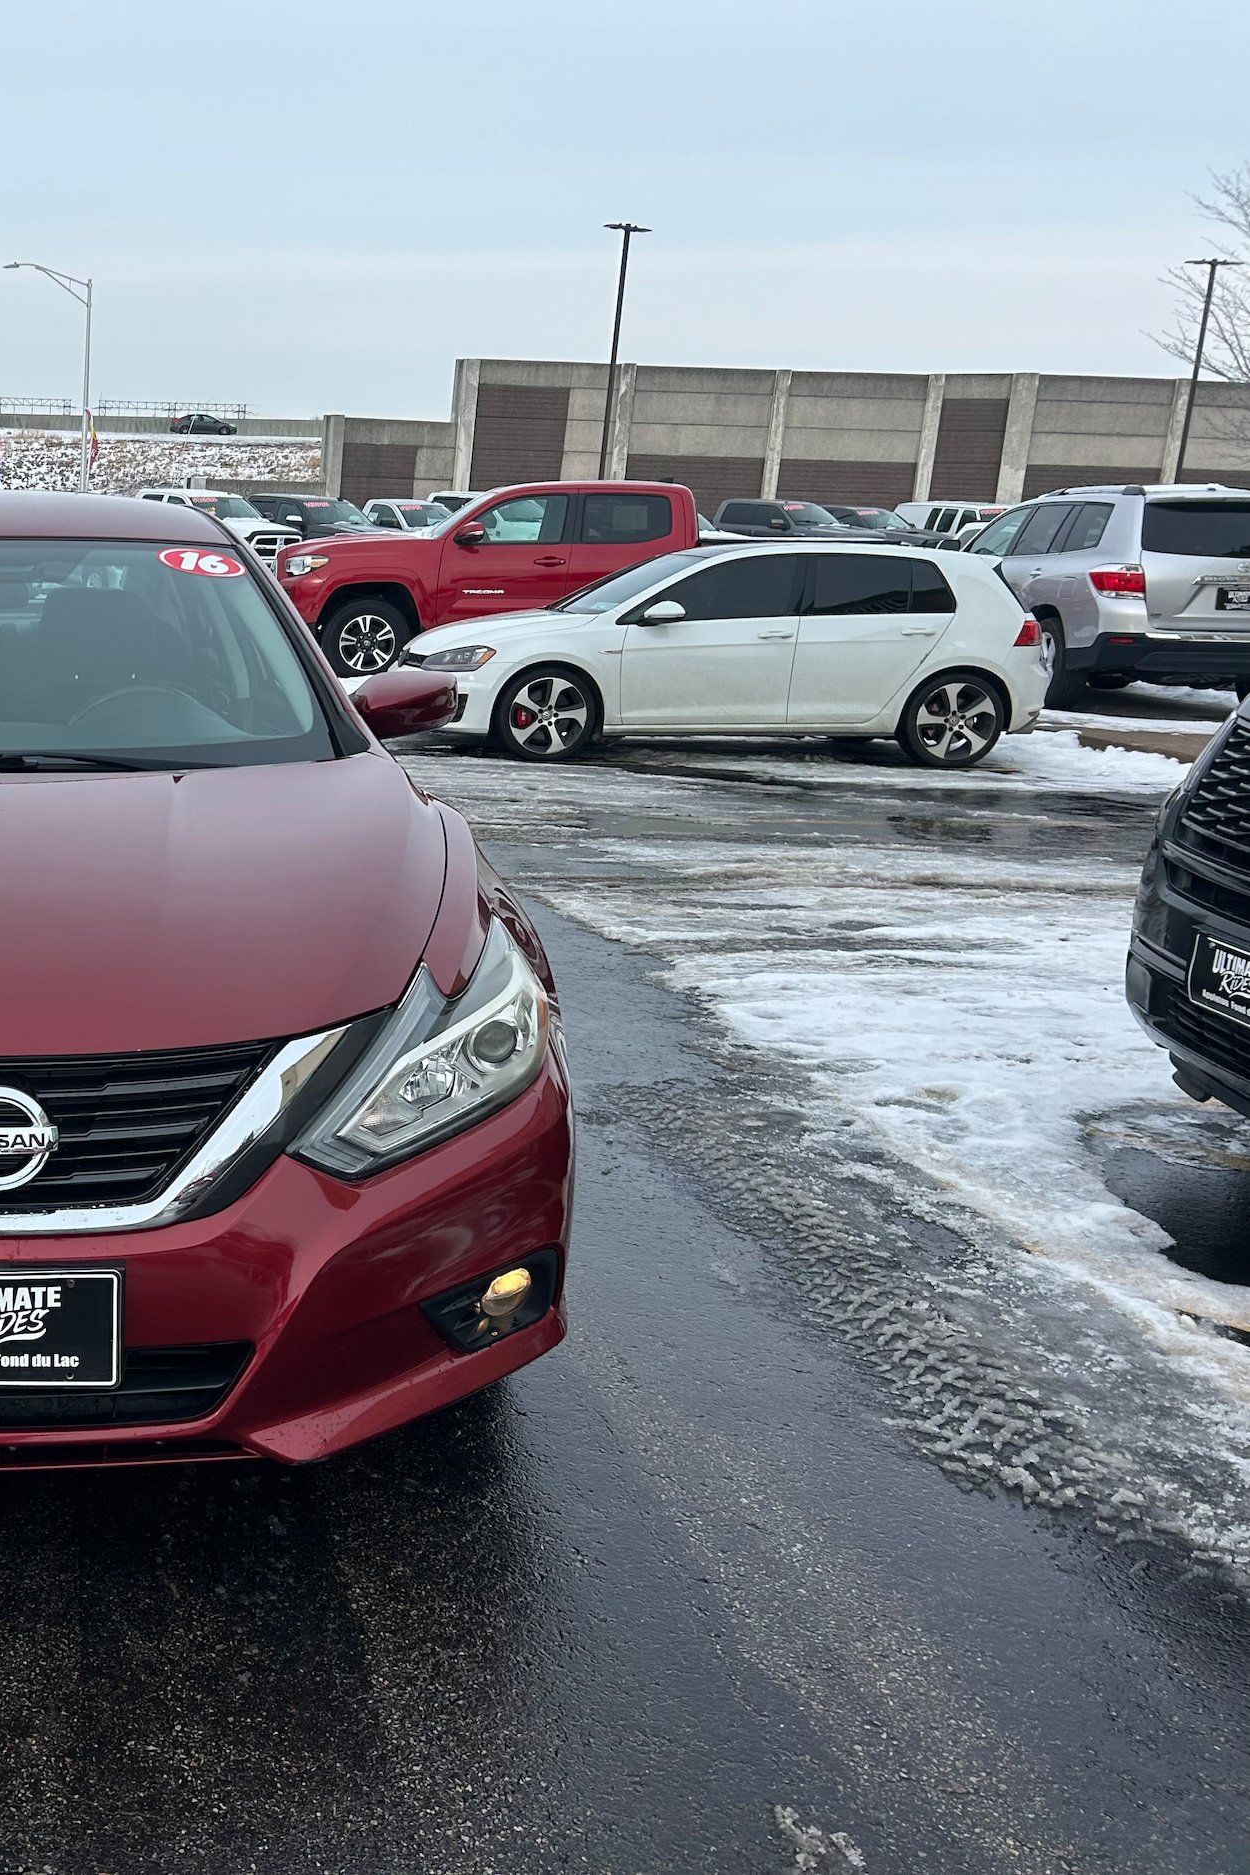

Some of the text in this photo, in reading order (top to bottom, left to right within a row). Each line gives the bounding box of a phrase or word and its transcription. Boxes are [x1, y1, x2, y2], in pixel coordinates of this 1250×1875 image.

[178, 551, 230, 574] 16
[31, 1353, 51, 1368] du
[53, 1353, 80, 1368] Lac
